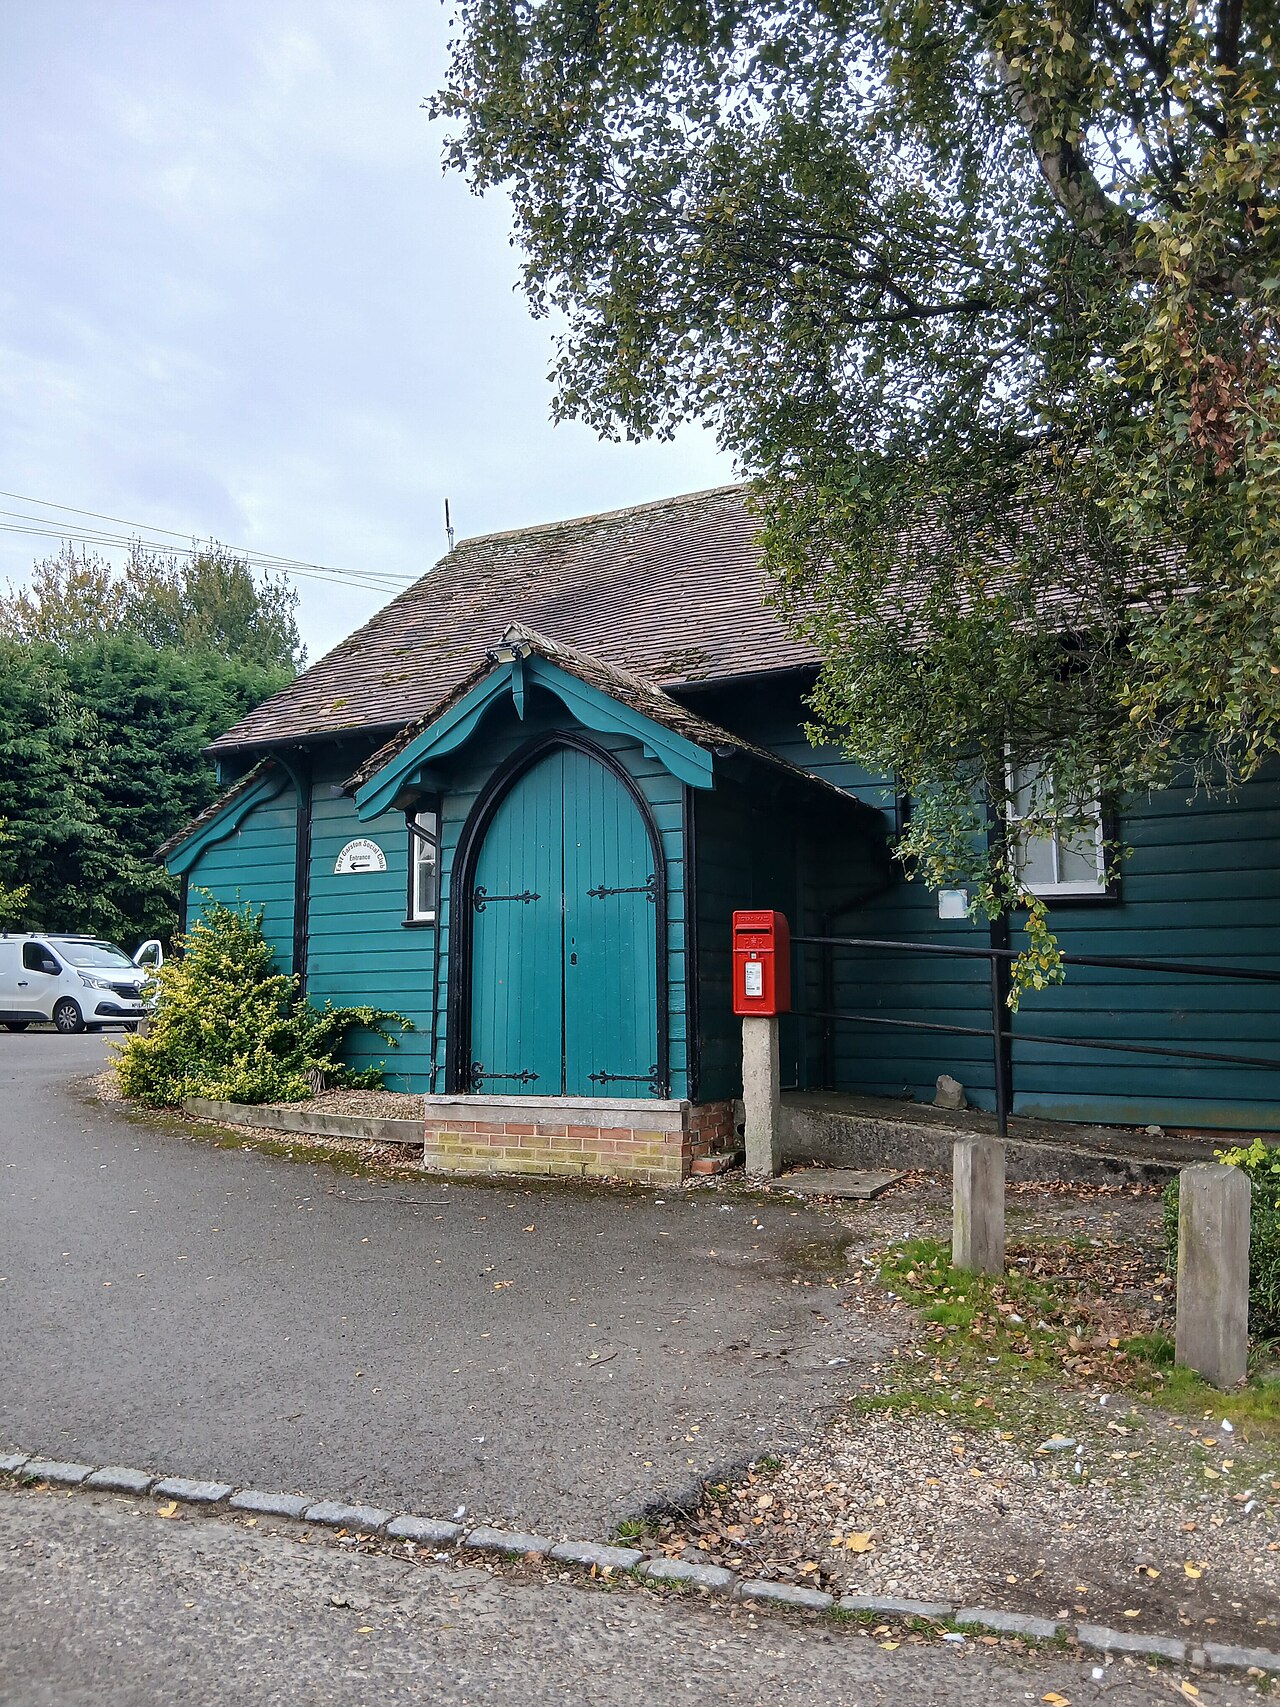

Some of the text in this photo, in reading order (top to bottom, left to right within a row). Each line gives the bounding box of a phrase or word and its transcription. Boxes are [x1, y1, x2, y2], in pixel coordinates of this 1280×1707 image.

[336, 840, 385, 871] East Garston Social Club
